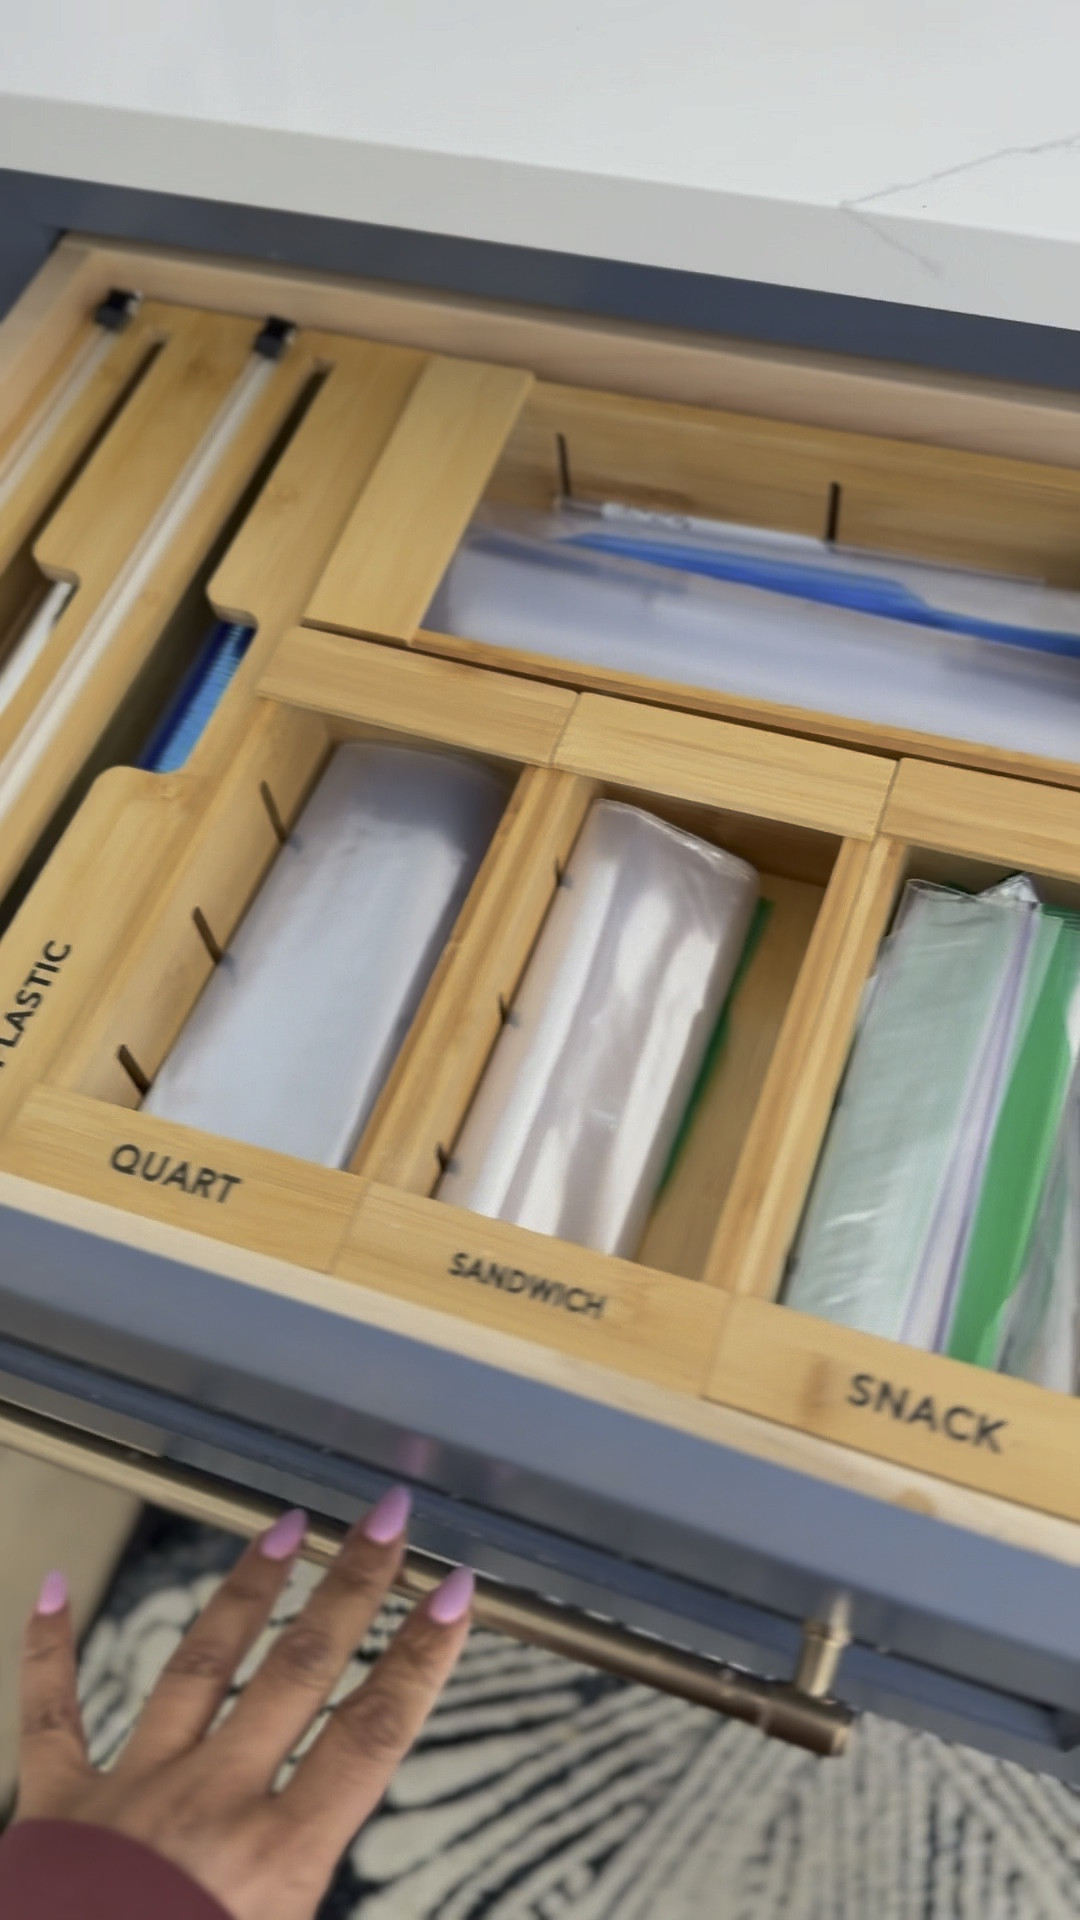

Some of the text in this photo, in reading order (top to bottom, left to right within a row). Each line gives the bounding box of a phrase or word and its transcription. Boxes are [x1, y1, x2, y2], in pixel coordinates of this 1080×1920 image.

[0, 939, 72, 1068] LASTIC
[110, 1143, 242, 1204] QUART
[448, 1252, 607, 1320] SANDWICH
[847, 1373, 1007, 1455] SNACK
